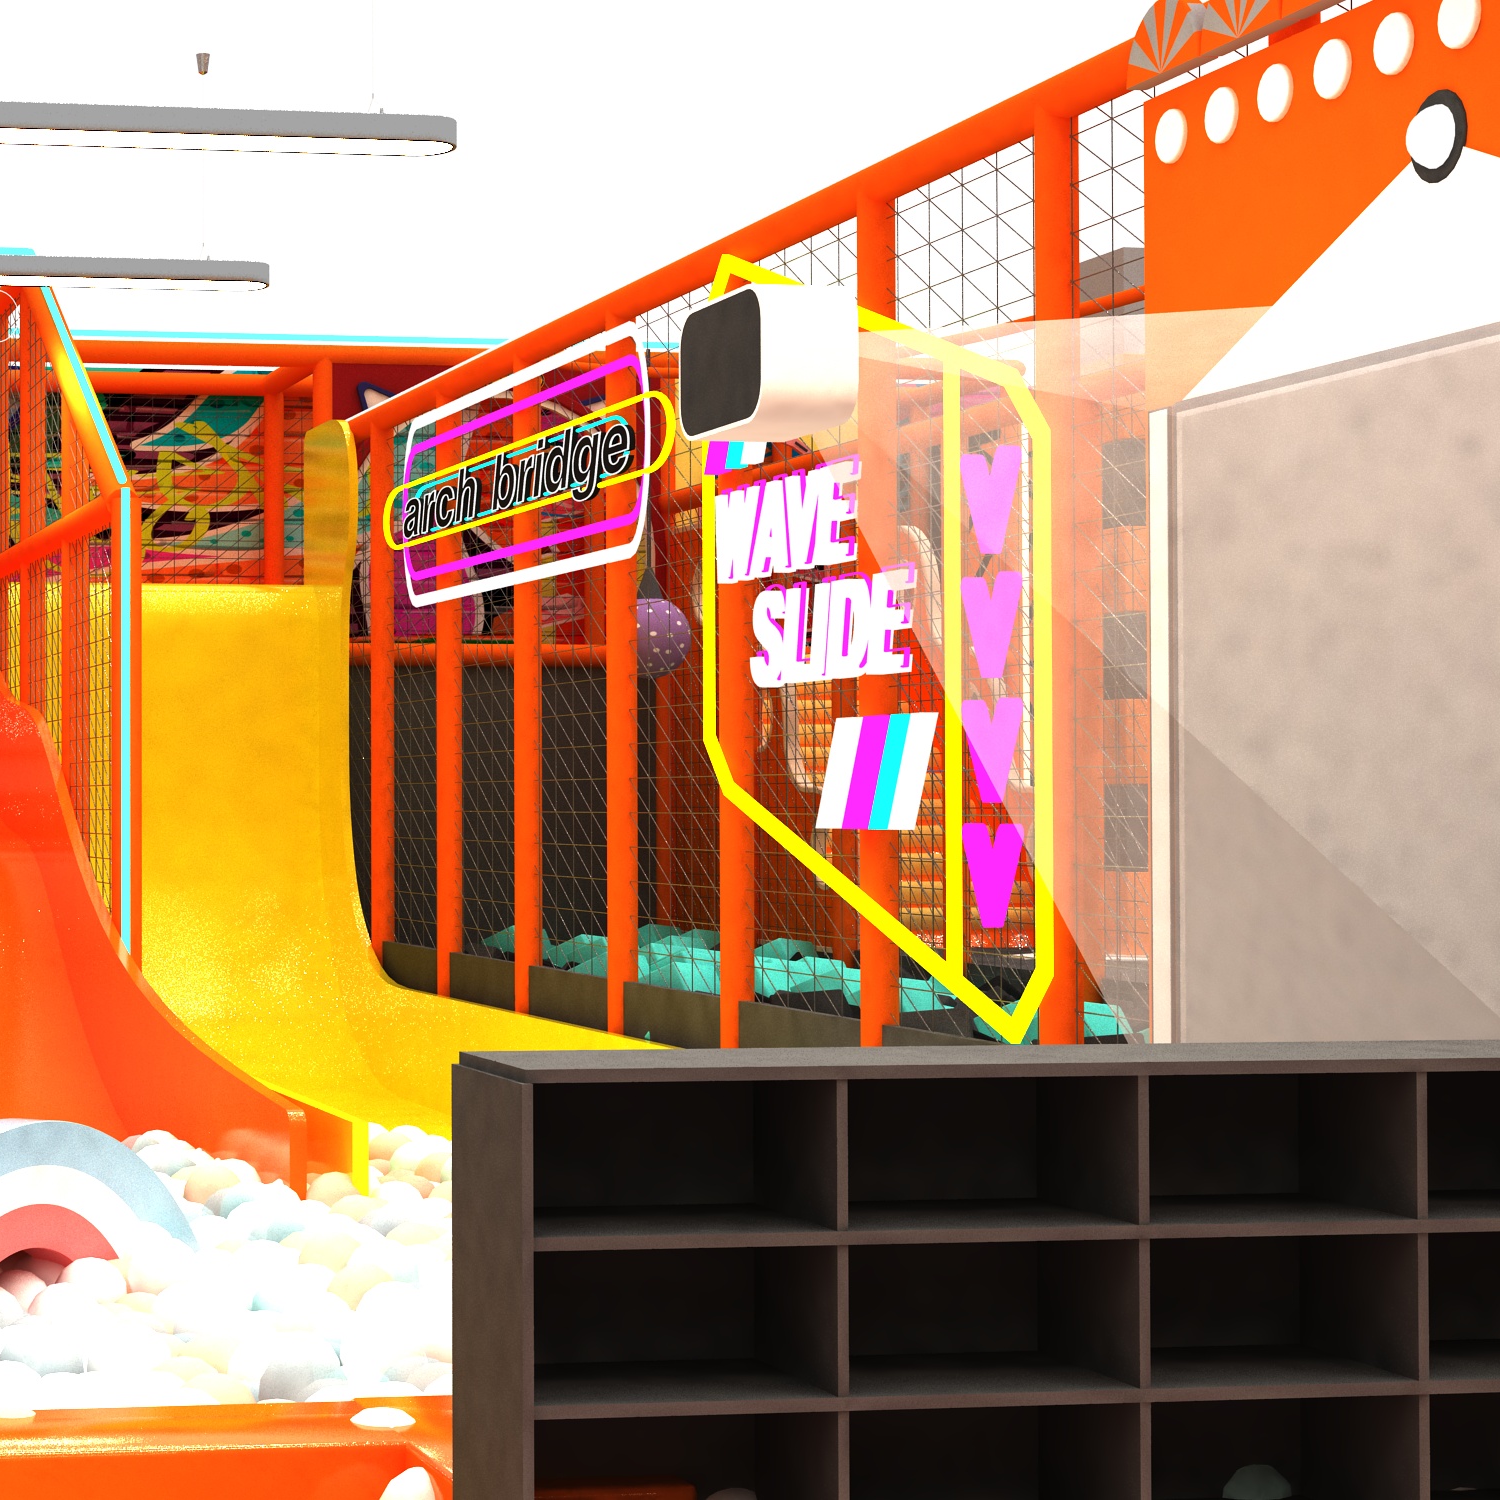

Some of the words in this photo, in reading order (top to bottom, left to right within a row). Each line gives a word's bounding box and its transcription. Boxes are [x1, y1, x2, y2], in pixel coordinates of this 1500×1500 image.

[403, 467, 483, 539] arch
[491, 423, 636, 502] bridge
[715, 454, 862, 584] WAVE
[750, 562, 918, 688] SLIDE
